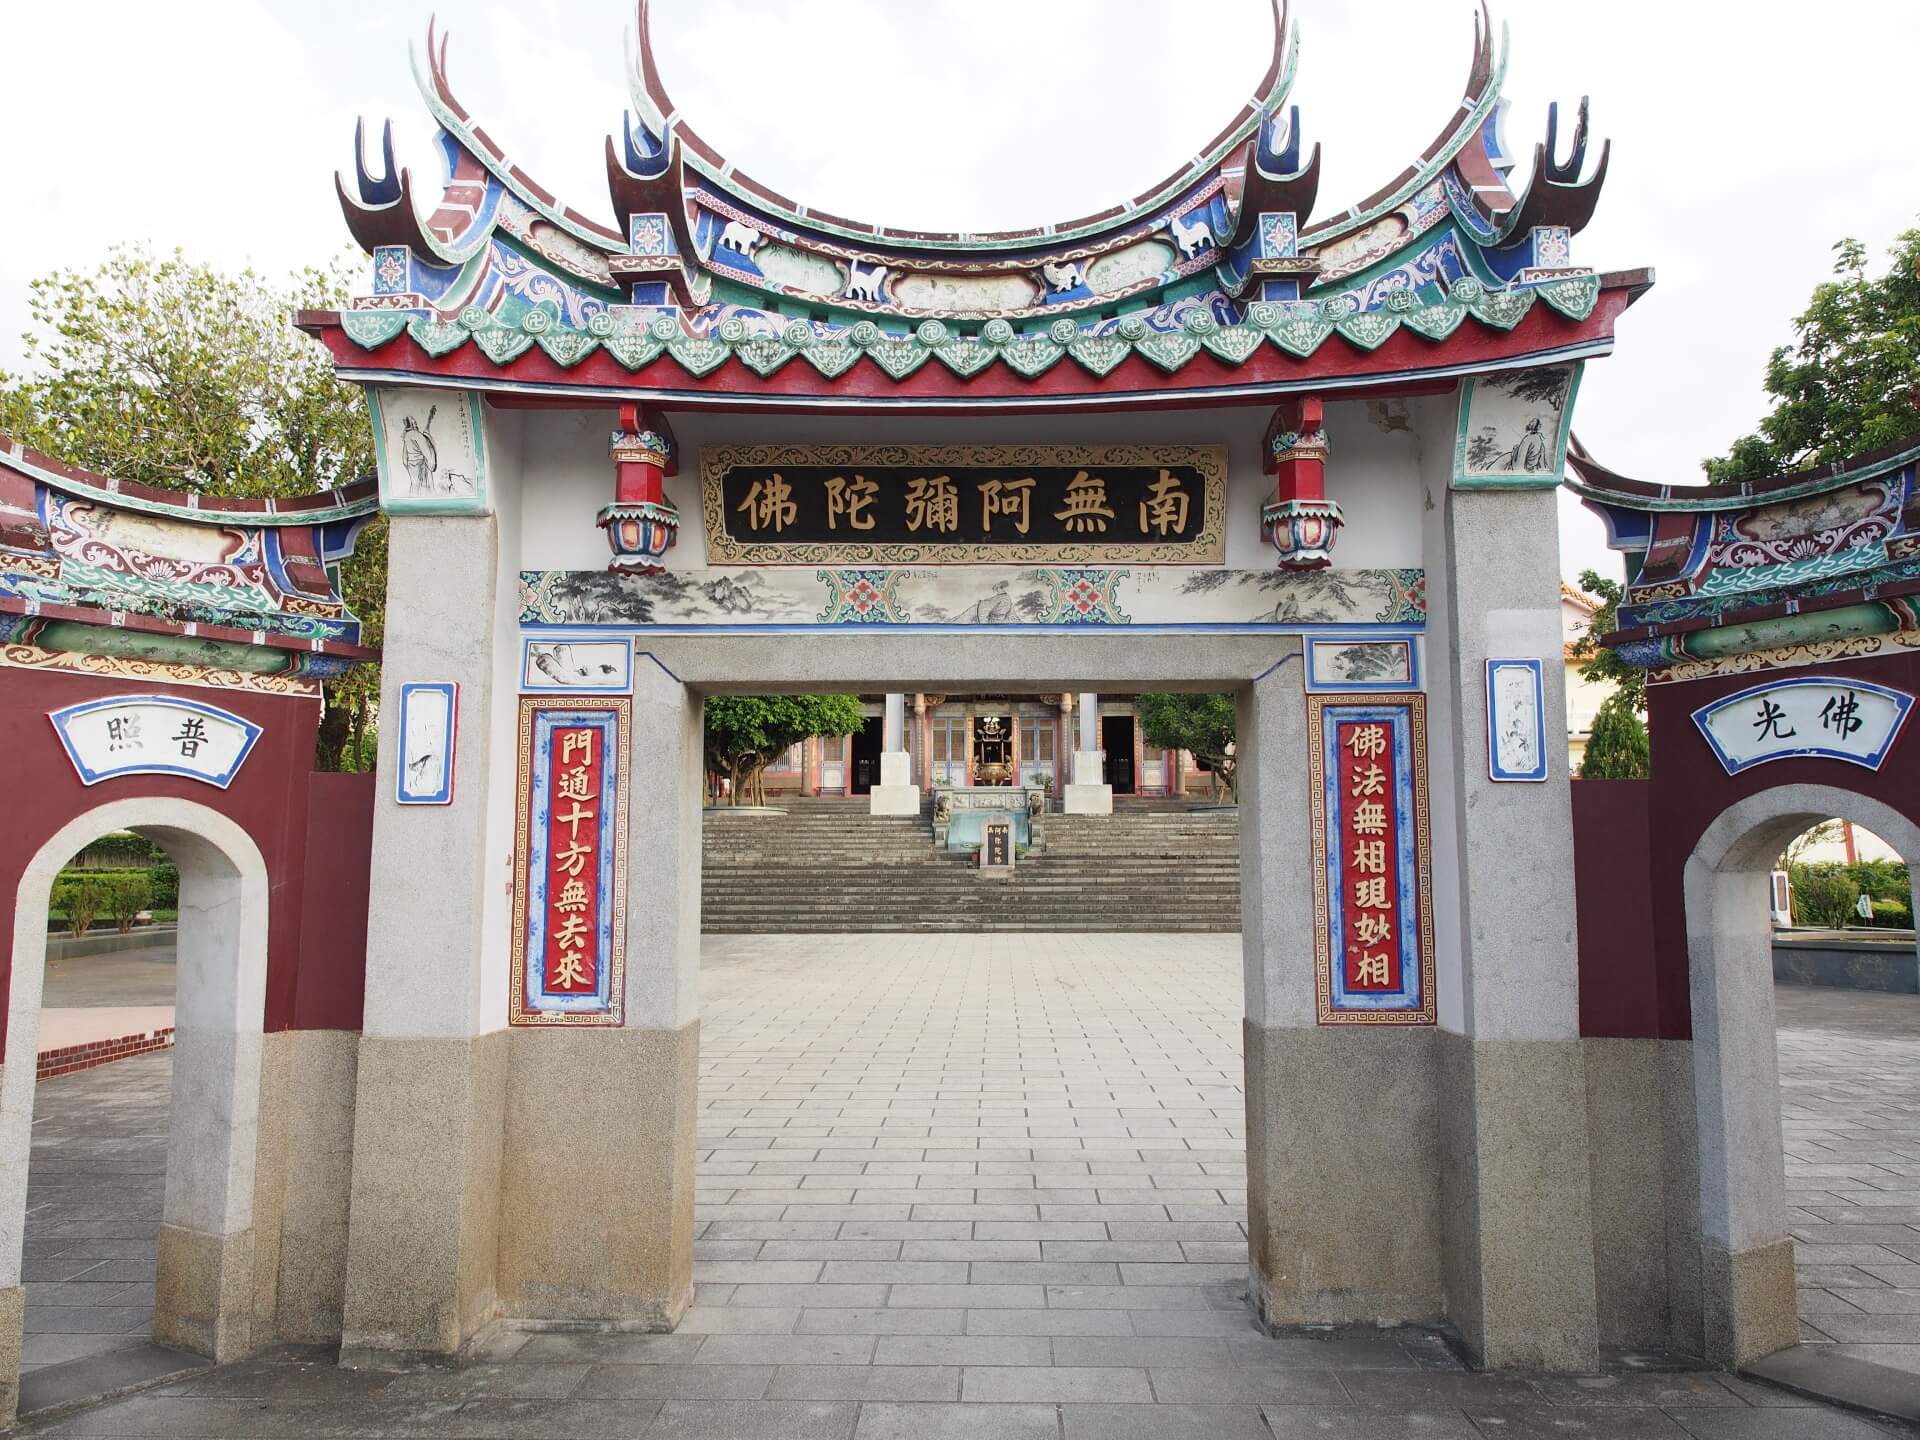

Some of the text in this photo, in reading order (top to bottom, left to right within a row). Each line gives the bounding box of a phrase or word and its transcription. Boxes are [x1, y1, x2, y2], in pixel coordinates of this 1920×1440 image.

[737, 470, 1190, 536] 南無阿彌陀佛
[106, 714, 209, 758] 普照
[1753, 691, 1863, 742] 佛光
[551, 728, 597, 990] 門通十方無去來
[1346, 724, 1392, 987] 佛法無相現妙相
